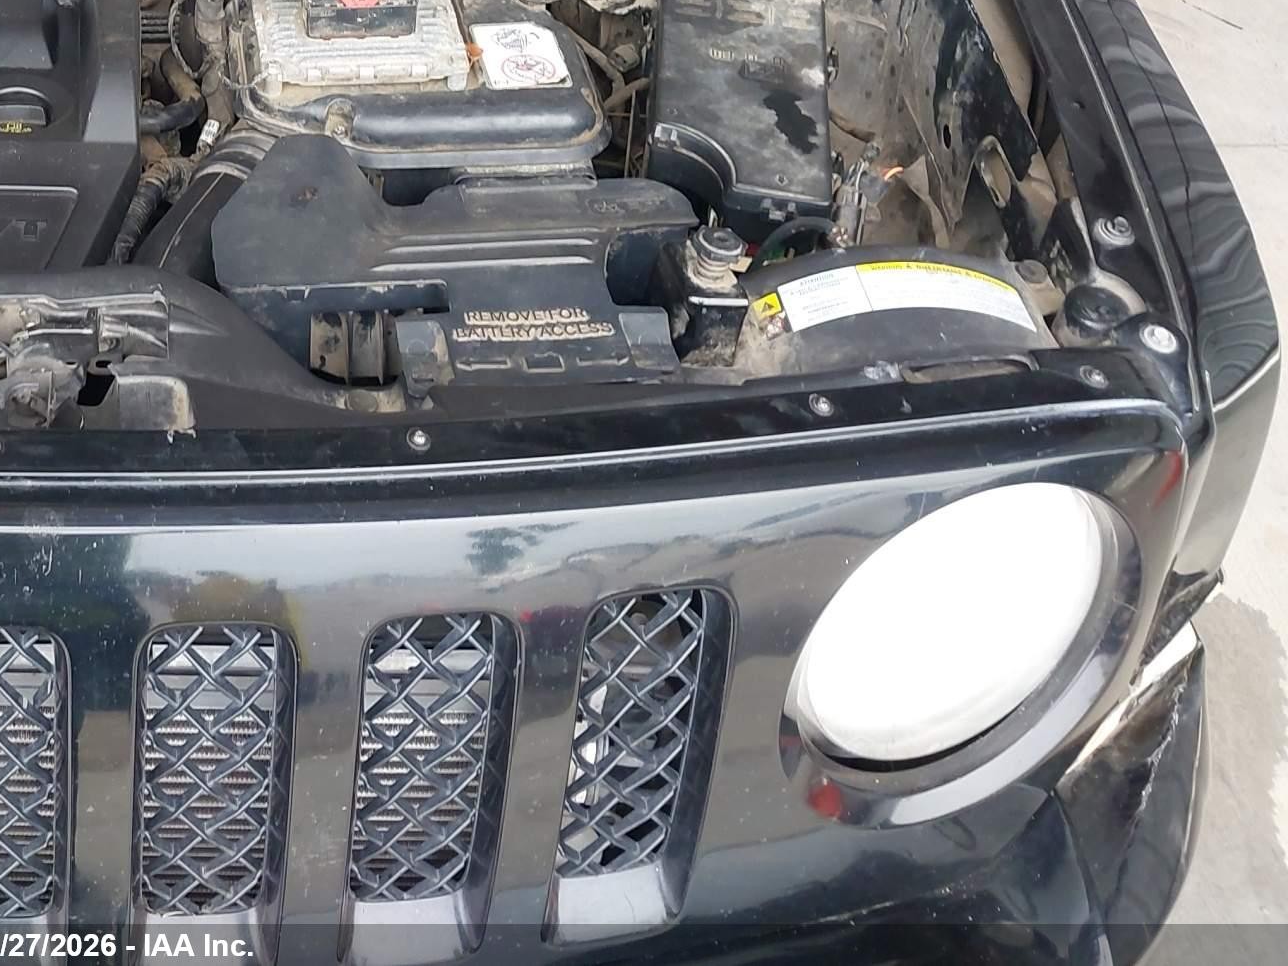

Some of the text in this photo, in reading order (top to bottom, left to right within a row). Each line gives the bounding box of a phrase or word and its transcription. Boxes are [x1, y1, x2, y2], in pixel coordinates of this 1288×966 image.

[464, 307, 589, 325] REMOVE FOR
[454, 322, 614, 341] BATTERY ACCESS
